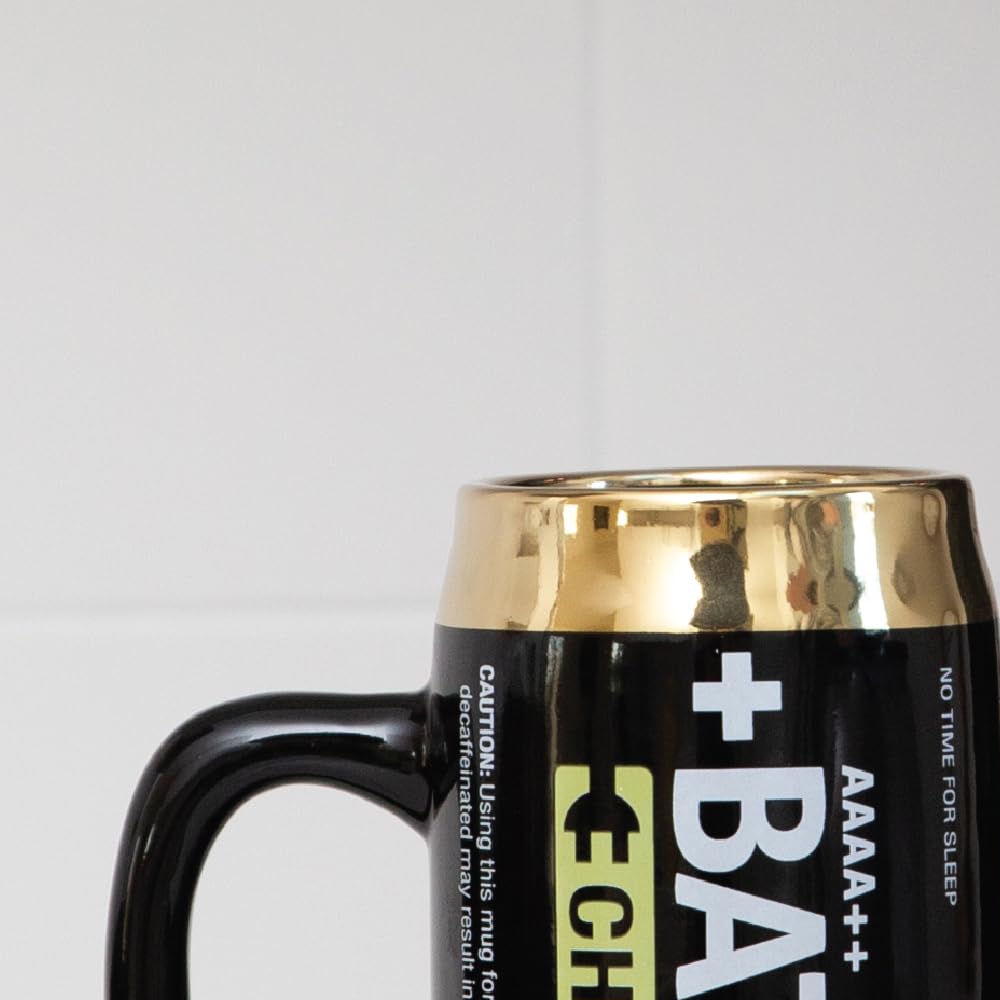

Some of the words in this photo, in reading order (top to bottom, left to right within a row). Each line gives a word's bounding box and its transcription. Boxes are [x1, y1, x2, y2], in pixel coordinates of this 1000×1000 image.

[939, 667, 954, 701] NO
[478, 665, 495, 776] CAUTION:
[940, 708, 955, 768] TIME
[458, 685, 473, 839] decaffeinated
[477, 783, 496, 850] Using
[941, 776, 956, 823] FOR
[457, 848, 473, 899] may
[479, 858, 496, 901] this
[842, 765, 877, 972] AAAA++
[943, 832, 958, 906] SLEEP
[460, 906, 476, 971] result
[477, 910, 495, 962] mug
[461, 980, 475, 999] in
